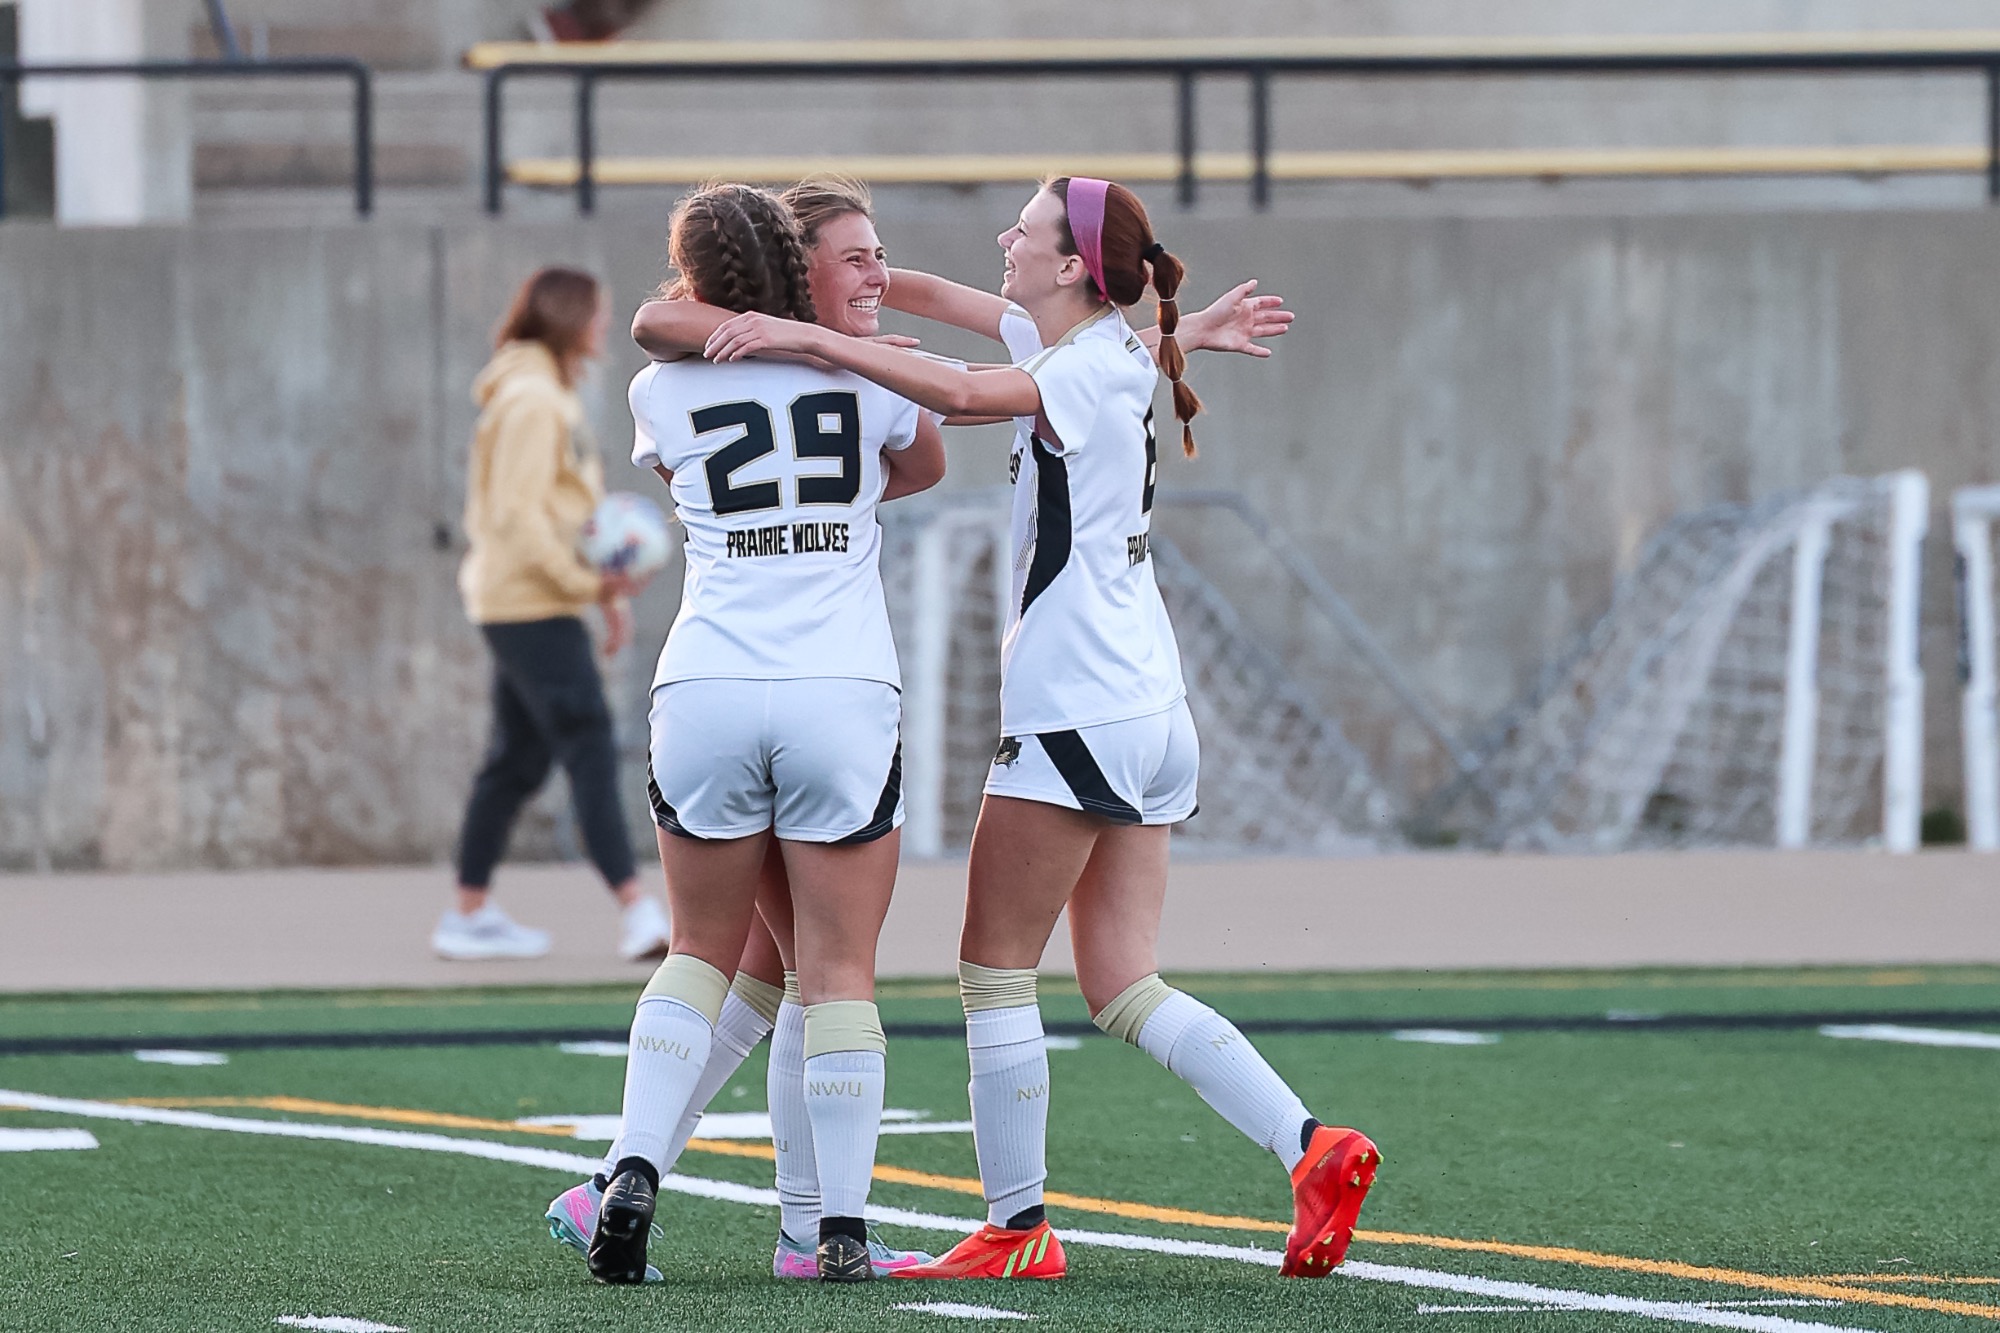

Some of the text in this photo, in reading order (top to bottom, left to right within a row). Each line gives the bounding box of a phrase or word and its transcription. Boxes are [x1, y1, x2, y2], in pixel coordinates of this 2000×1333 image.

[687, 388, 862, 519] 29
[726, 522, 850, 558] PRAIRIE WOLVES
[637, 1035, 691, 1061] NWU
[809, 1081, 863, 1097] NWU
